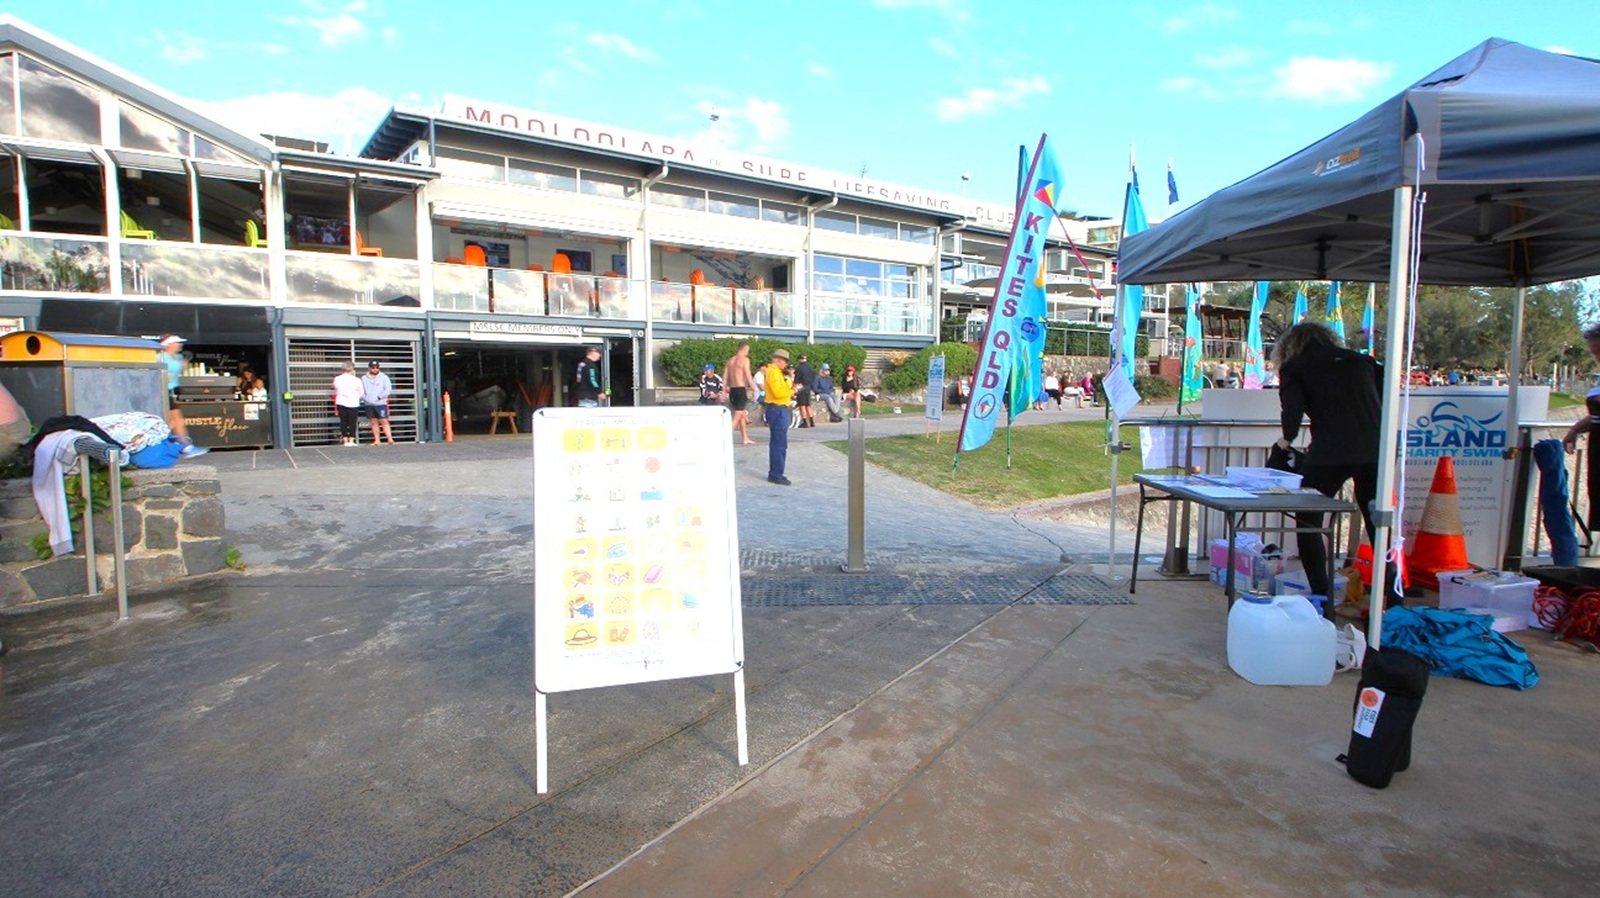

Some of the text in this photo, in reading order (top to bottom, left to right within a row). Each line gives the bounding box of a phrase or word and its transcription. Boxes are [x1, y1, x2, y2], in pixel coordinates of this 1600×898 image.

[508, 324, 555, 333] MEMBERS
[982, 212, 1043, 389] KITES QLD
